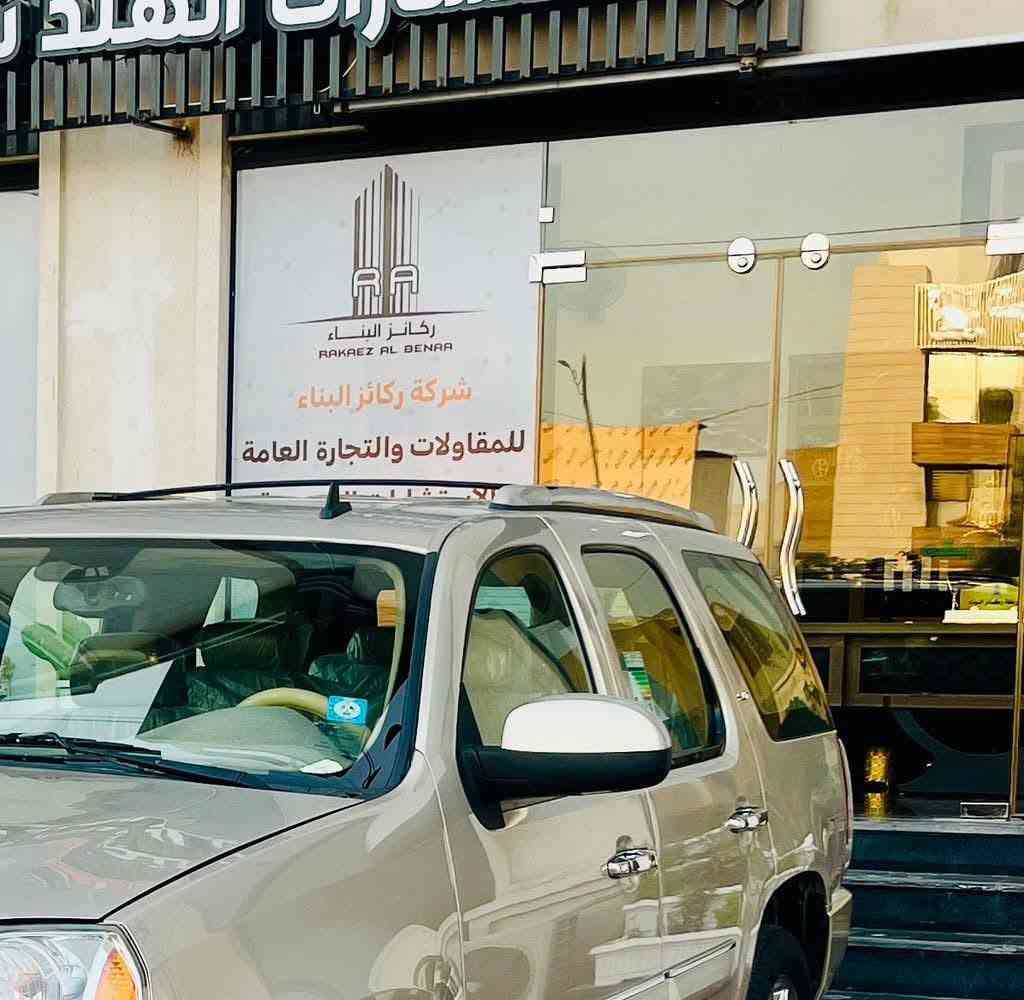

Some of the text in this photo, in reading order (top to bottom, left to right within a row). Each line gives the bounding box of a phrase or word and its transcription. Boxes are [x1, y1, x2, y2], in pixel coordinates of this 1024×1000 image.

[319, 342, 453, 360] RAKAEZ AL BENAA
[297, 376, 472, 413] شركة ركائز البناء
[241, 429, 526, 467] للمقاولات والتجارة العامة
